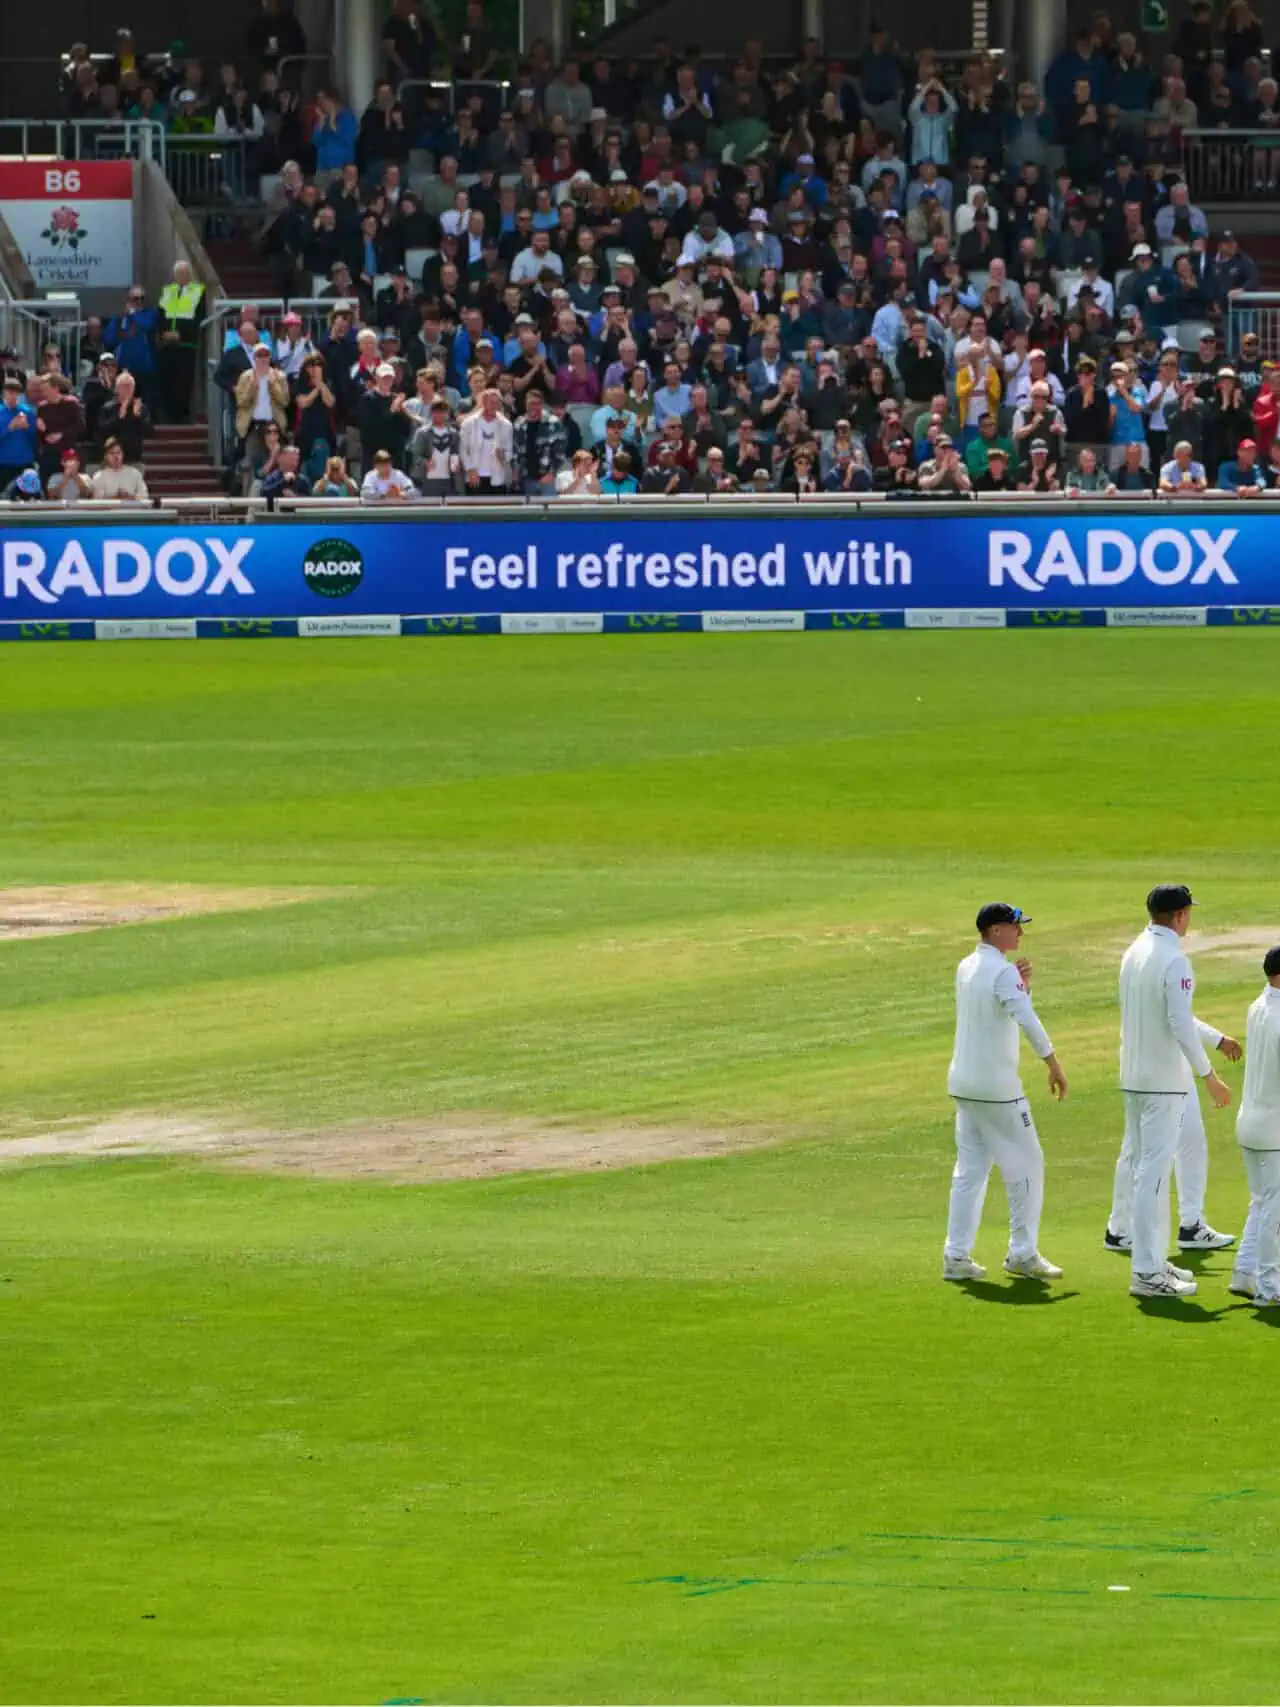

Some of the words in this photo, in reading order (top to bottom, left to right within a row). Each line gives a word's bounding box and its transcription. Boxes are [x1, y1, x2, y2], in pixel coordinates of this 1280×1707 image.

[44, 169, 81, 193] B6
[27, 251, 103, 266] Lancashire
[38, 266, 89, 281] Cricket
[3, 538, 255, 603] RADOX
[303, 561, 362, 577] RADOX
[446, 544, 537, 589] Feel
[554, 542, 785, 588] refreshed
[803, 540, 911, 585] with
[989, 528, 1243, 592] RADOX
